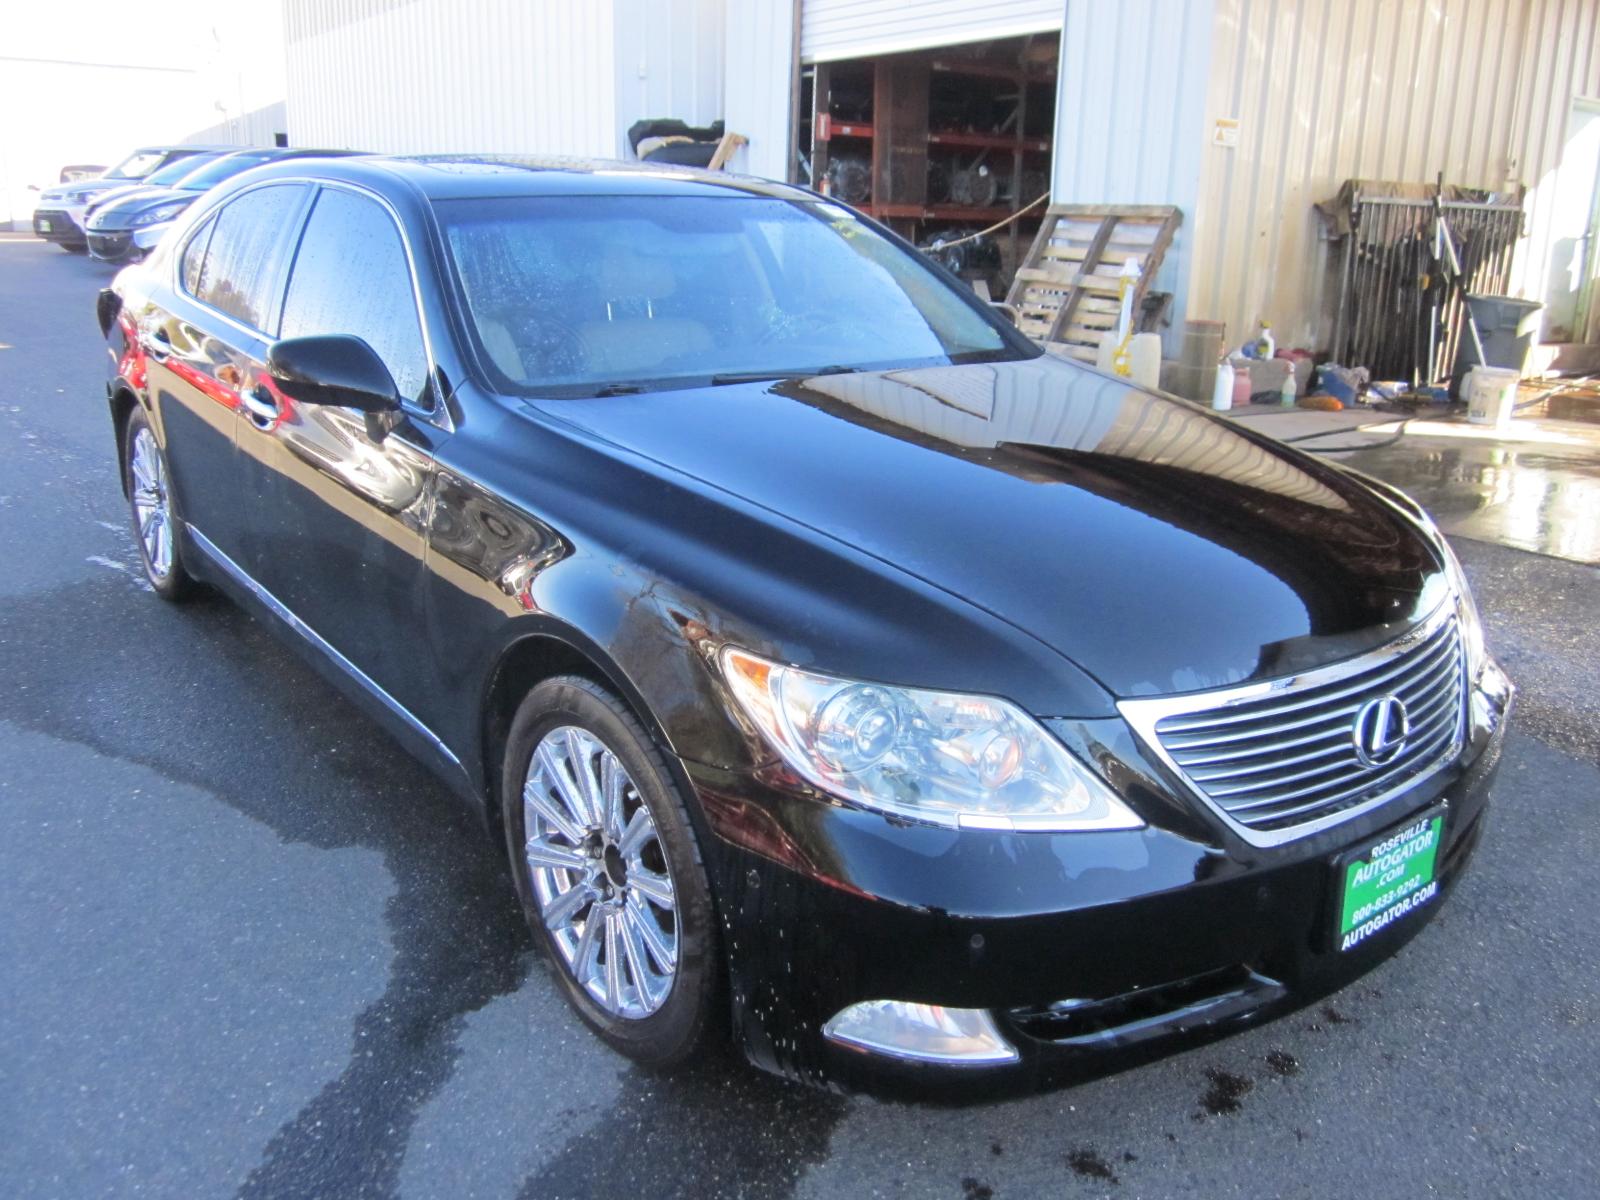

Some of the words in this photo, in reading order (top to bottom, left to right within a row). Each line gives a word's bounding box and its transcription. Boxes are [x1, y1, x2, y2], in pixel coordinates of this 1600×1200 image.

[1352, 830, 1434, 888] AUTOGATOR
[1371, 819, 1429, 858] ROSEVILLE
[1352, 873, 1421, 924] 800-833-9292
[1376, 864, 1405, 888] .COM
[1341, 881, 1437, 951] AUTOGATOR.COM
